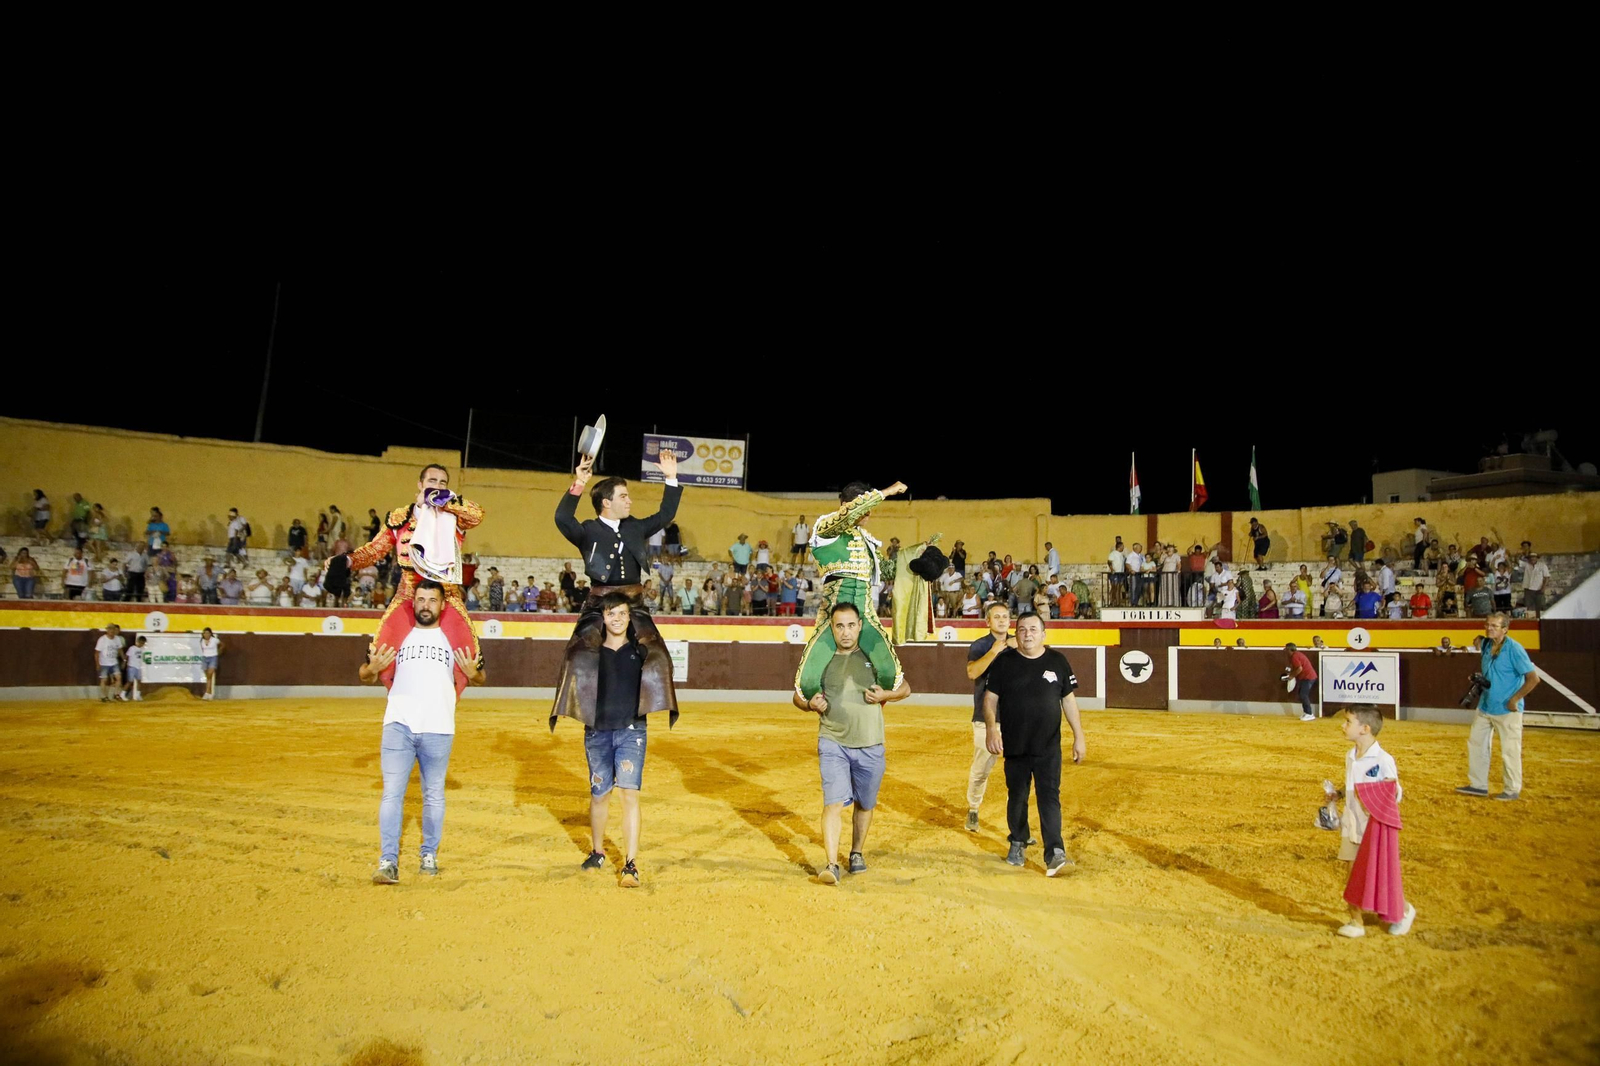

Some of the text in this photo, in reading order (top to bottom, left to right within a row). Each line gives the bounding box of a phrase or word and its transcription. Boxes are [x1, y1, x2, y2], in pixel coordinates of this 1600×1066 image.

[726, 477, 738, 485] 596
[1121, 610, 1182, 620] TORILES
[153, 618, 161, 627] 5
[329, 621, 337, 630] 5
[490, 625, 497, 633] 5
[1354, 633, 1363, 643] 4
[397, 645, 450, 668] HILFIGER
[1333, 679, 1385, 693] Mayfra
